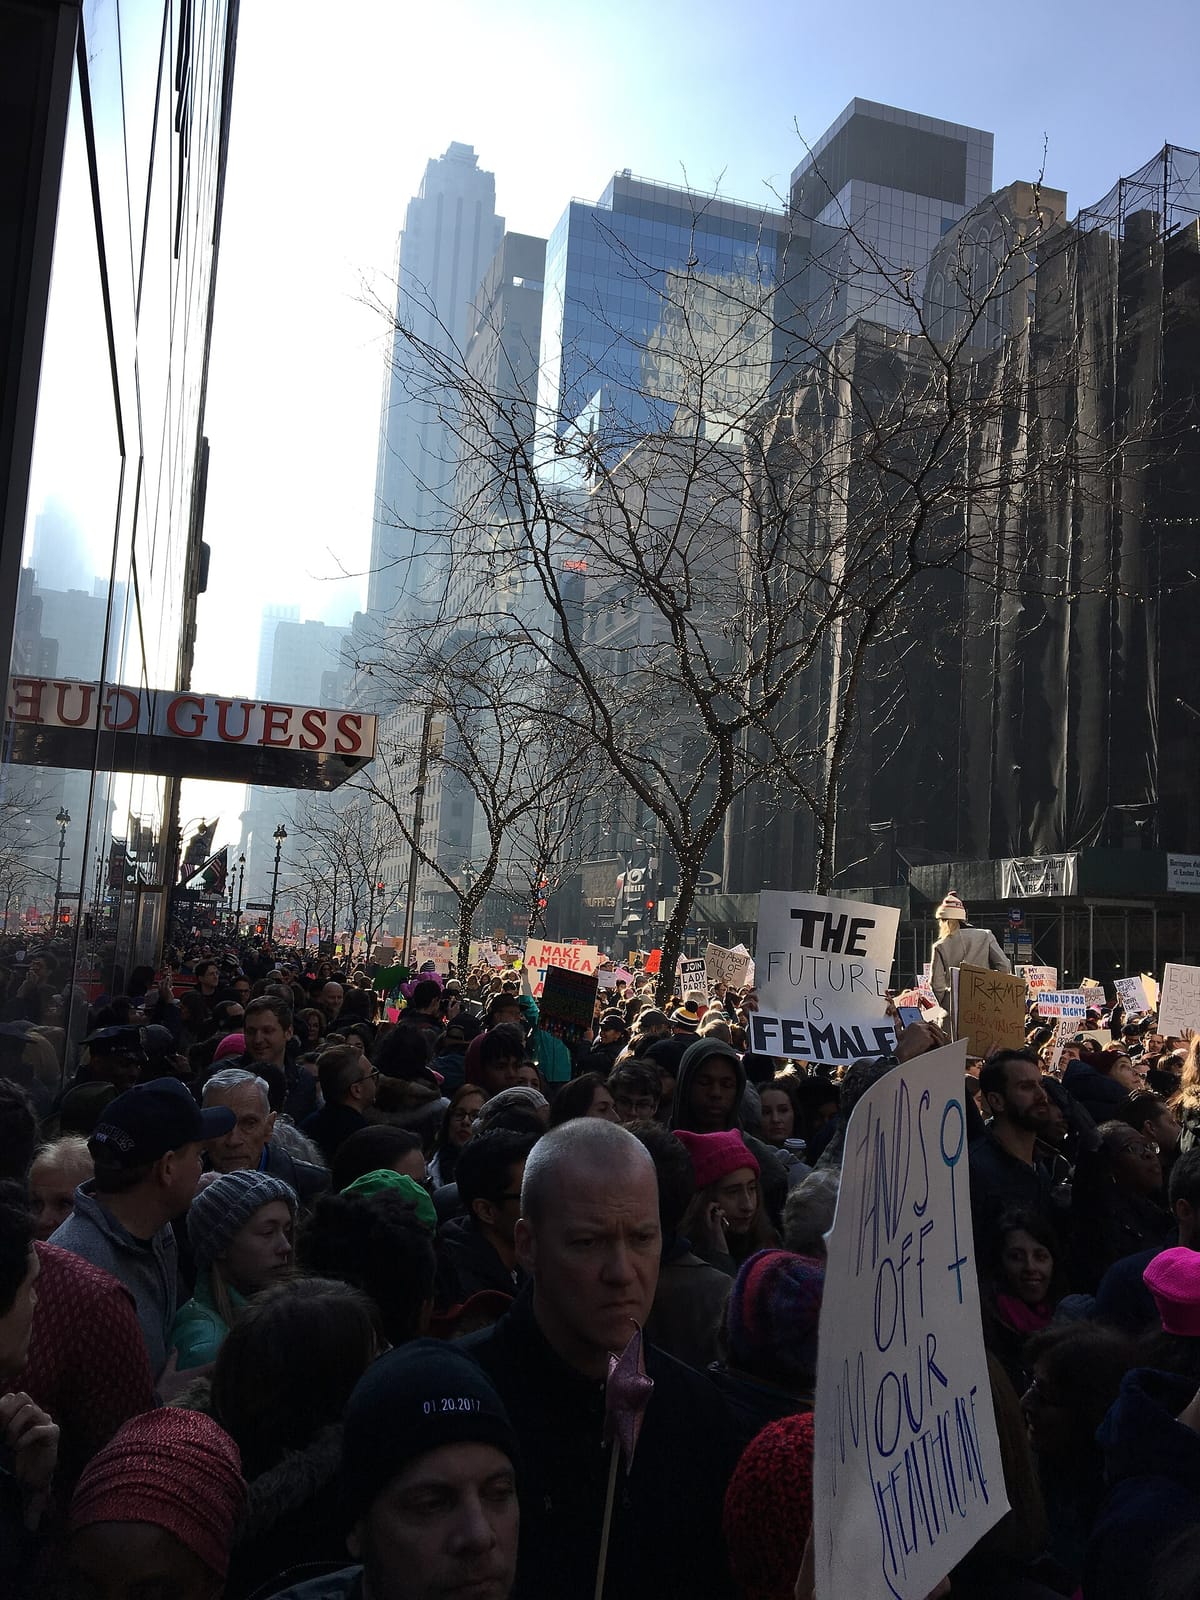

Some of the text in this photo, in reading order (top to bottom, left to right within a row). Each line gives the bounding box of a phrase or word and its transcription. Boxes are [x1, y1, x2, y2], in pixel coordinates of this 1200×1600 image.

[166, 696, 363, 753] GUESS
[1040, 882, 1059, 892] OPEN
[790, 908, 876, 957] THE
[541, 945, 582, 959] MAKE
[527, 955, 592, 972] AMERICA
[685, 961, 702, 972] JOIN
[728, 963, 742, 974] OF
[682, 971, 705, 984] LADY
[716, 968, 734, 982] US
[768, 951, 889, 998] FUTURE
[683, 981, 706, 992] PARTS
[1038, 993, 1059, 1003] STAND
[1060, 994, 1070, 1004] UP
[1071, 995, 1085, 1005] FOR
[978, 1001, 987, 1012] IS
[1039, 1006, 1086, 1017] HUMAN RIGHTS
[752, 1015, 897, 1060] FEMALE
[850, 1078, 931, 1276] HANDS
[874, 1220, 934, 1352] OFF
